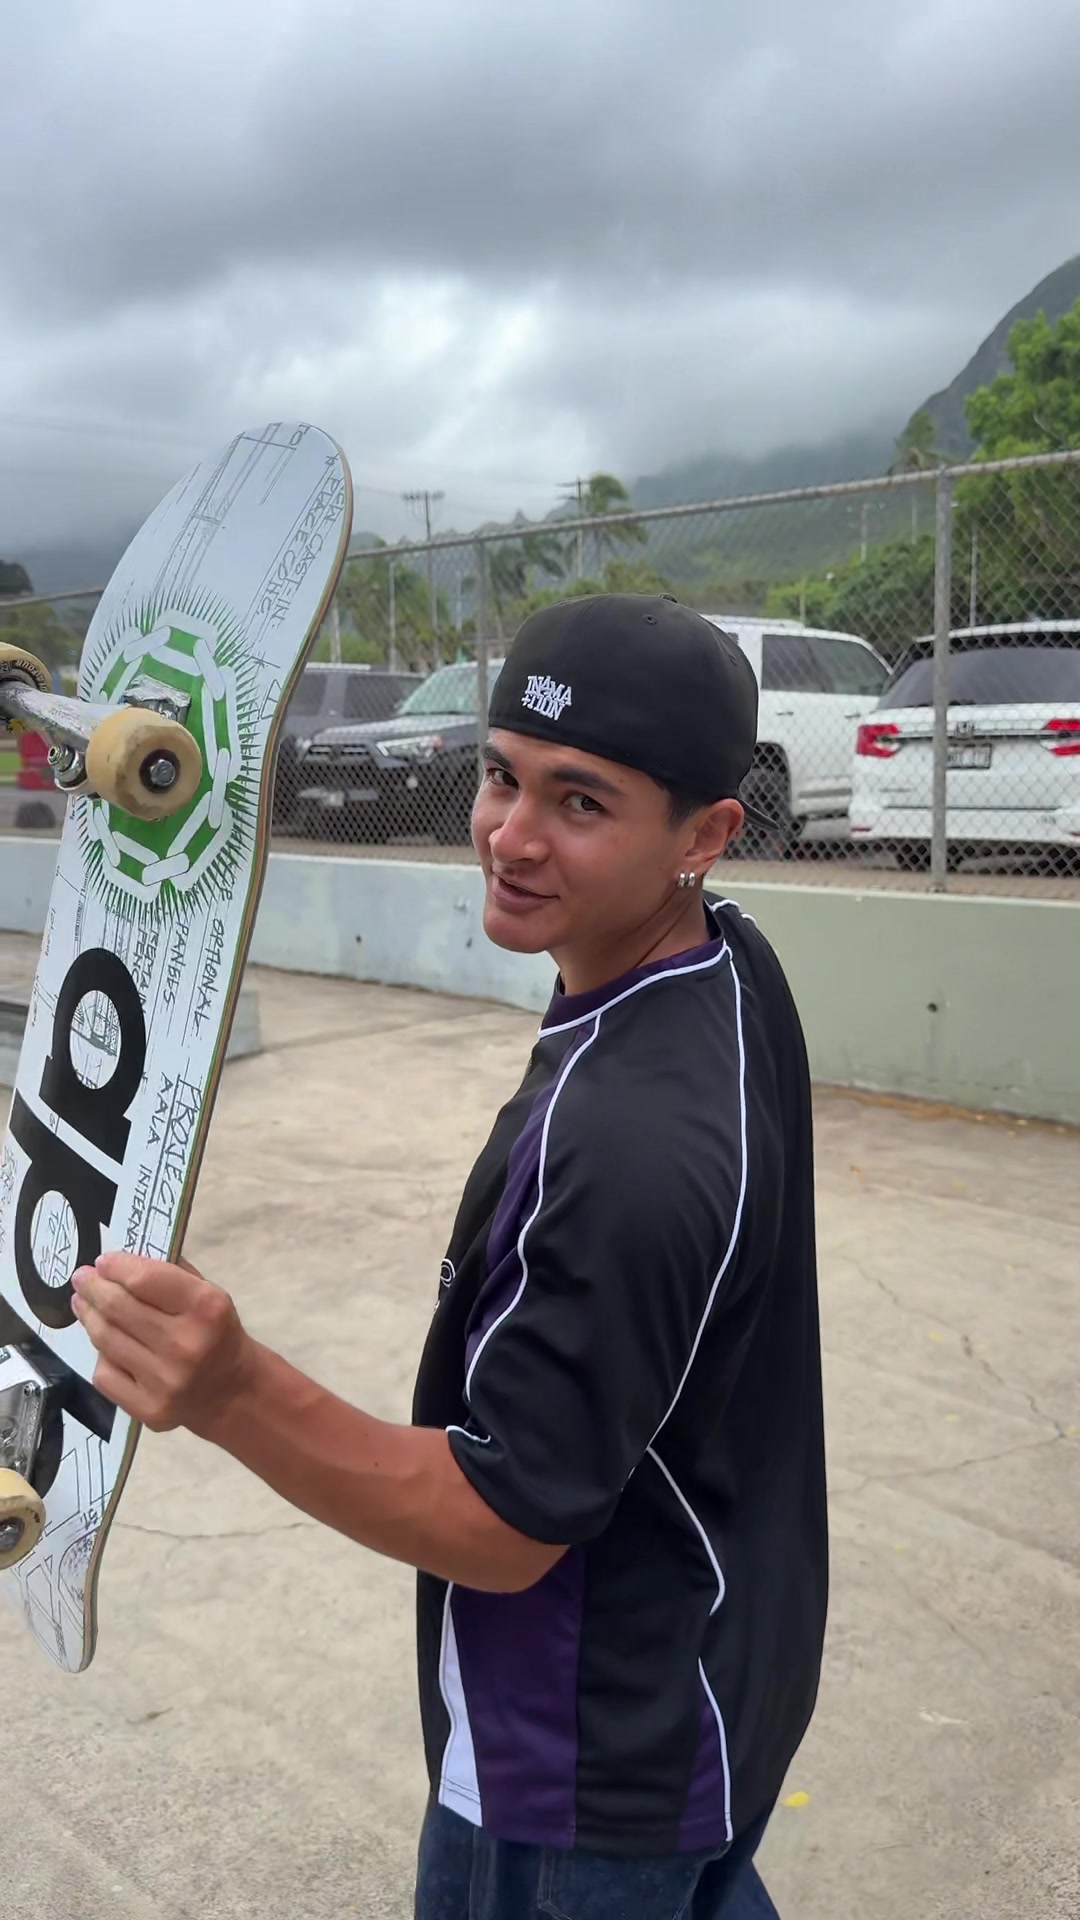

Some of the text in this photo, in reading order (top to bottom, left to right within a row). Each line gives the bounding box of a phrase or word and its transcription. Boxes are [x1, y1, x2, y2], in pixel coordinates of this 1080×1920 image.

[294, 477, 342, 542] PLACE
[131, 927, 148, 984] FENC
[163, 921, 189, 1011] PANELS
[193, 918, 225, 1037] OPTIONAL
[124, 1072, 174, 1256] AALA INTERNA
[150, 1074, 203, 1228] PROJECT
